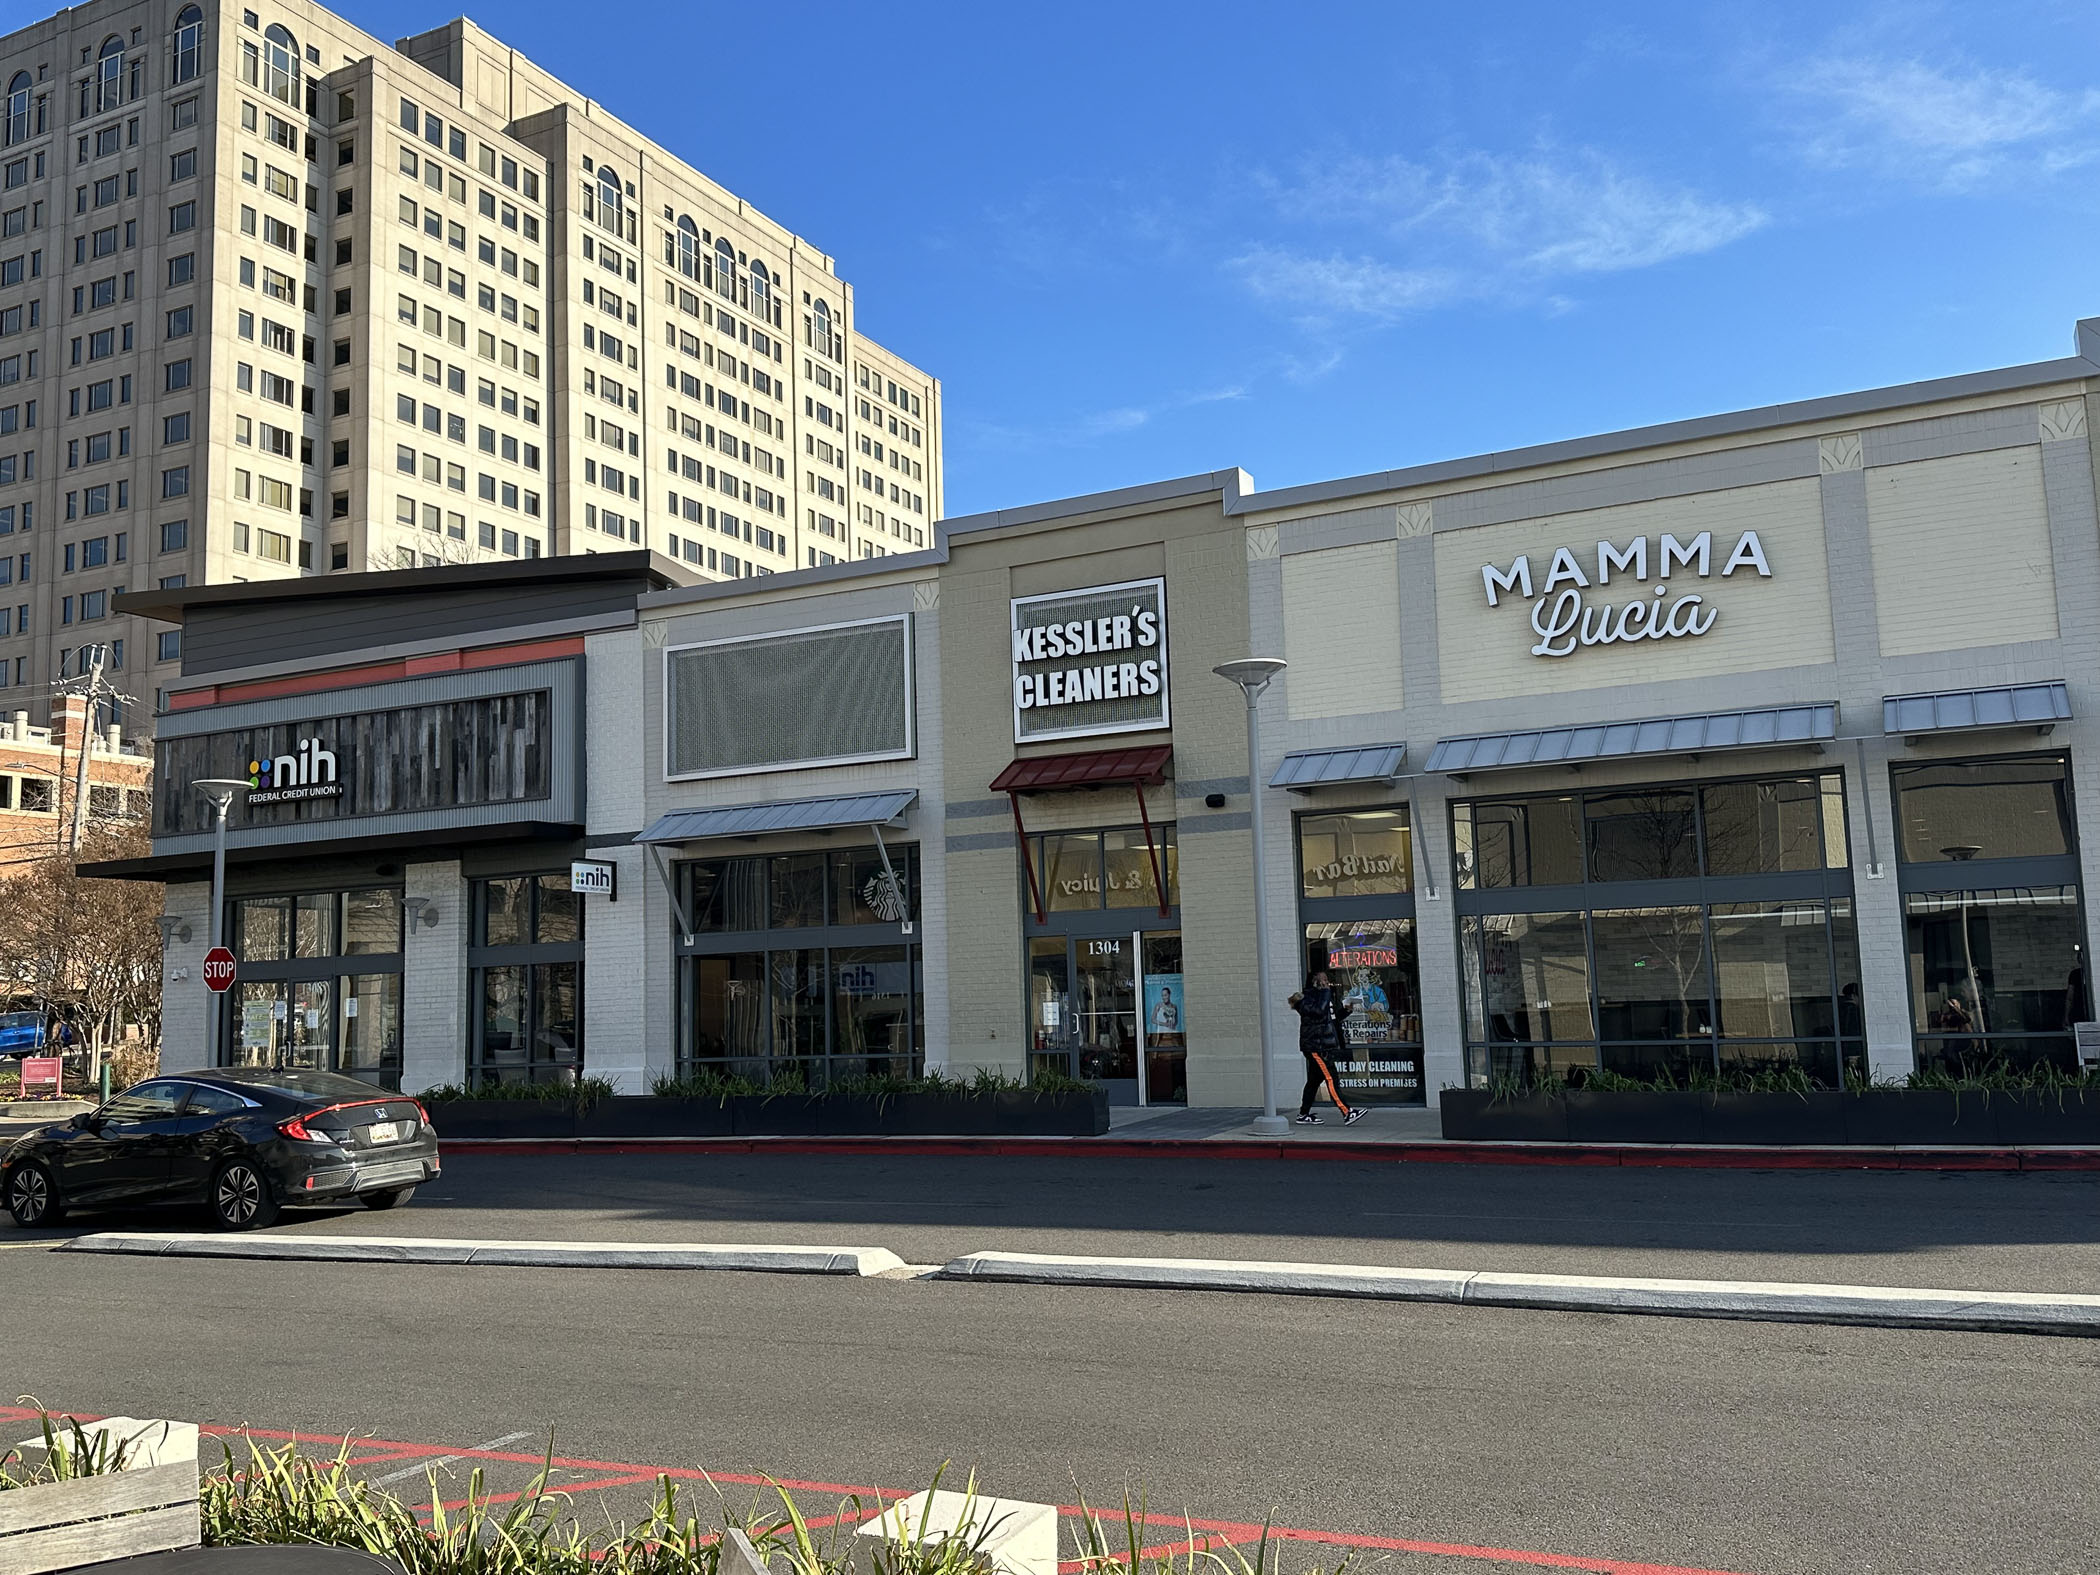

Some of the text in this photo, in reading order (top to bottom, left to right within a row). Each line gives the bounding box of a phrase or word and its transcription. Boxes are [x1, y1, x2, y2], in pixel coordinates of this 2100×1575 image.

[1480, 529, 1772, 608] MAMMA
[1530, 583, 1718, 657] Lucia
[1013, 604, 1157, 662] KESSLER'S
[1015, 659, 1160, 709] CLEANERS
[274, 738, 336, 788] nih
[248, 785, 336, 803] FEDERAL CREDIT UNION
[586, 867, 609, 887] nih
[1088, 940, 1120, 955] 1304
[1329, 950, 1397, 968] ALTERATIONS
[204, 961, 234, 979] STOP
[1344, 1028, 1388, 1040] & Repairs
[1348, 1061, 1367, 1072] DAY
[1368, 1060, 1415, 1072] CLEANING
[1368, 1078, 1379, 1088] ON
[1380, 1078, 1418, 1088] PREMISES
